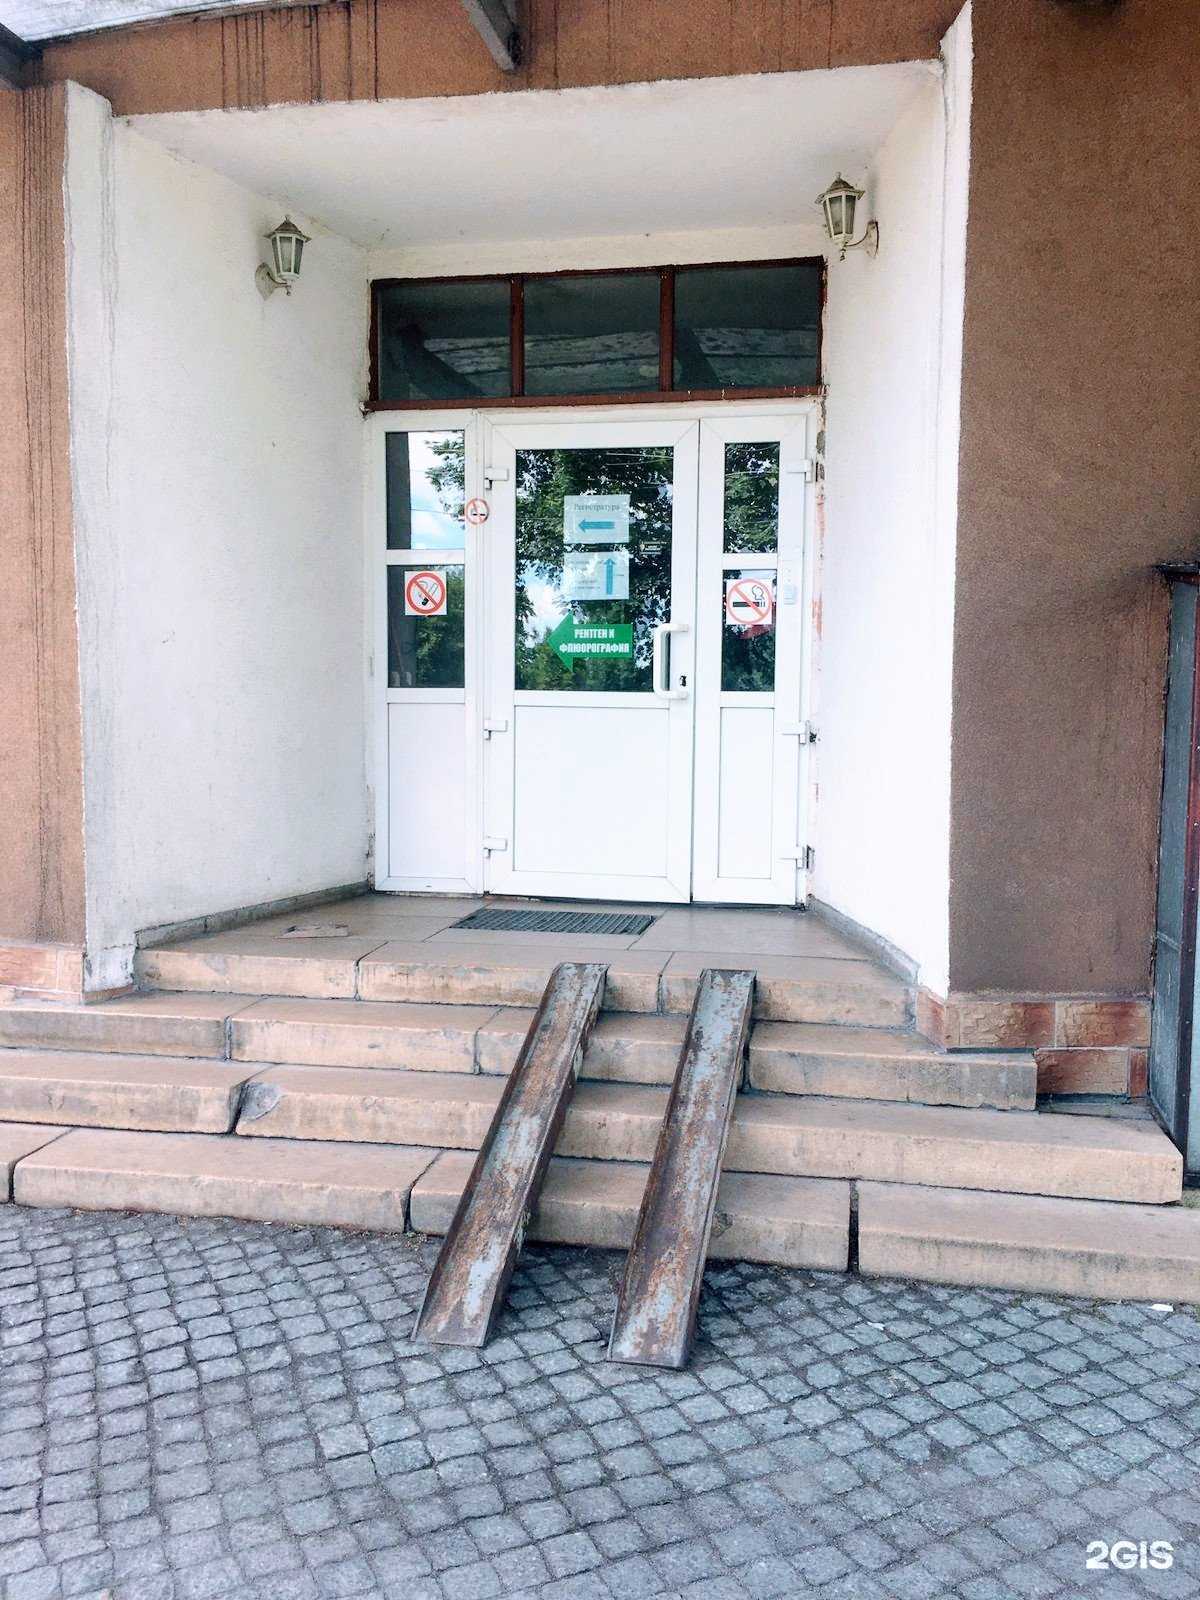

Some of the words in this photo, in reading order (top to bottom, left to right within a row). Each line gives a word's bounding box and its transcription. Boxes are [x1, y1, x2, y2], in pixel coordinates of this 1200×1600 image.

[574, 503, 620, 512] Регистратура
[574, 628, 608, 639] РЕНТГЕН
[608, 628, 615, 639] И
[559, 643, 629, 653] ФЛЮОРОГРАФИЯ
